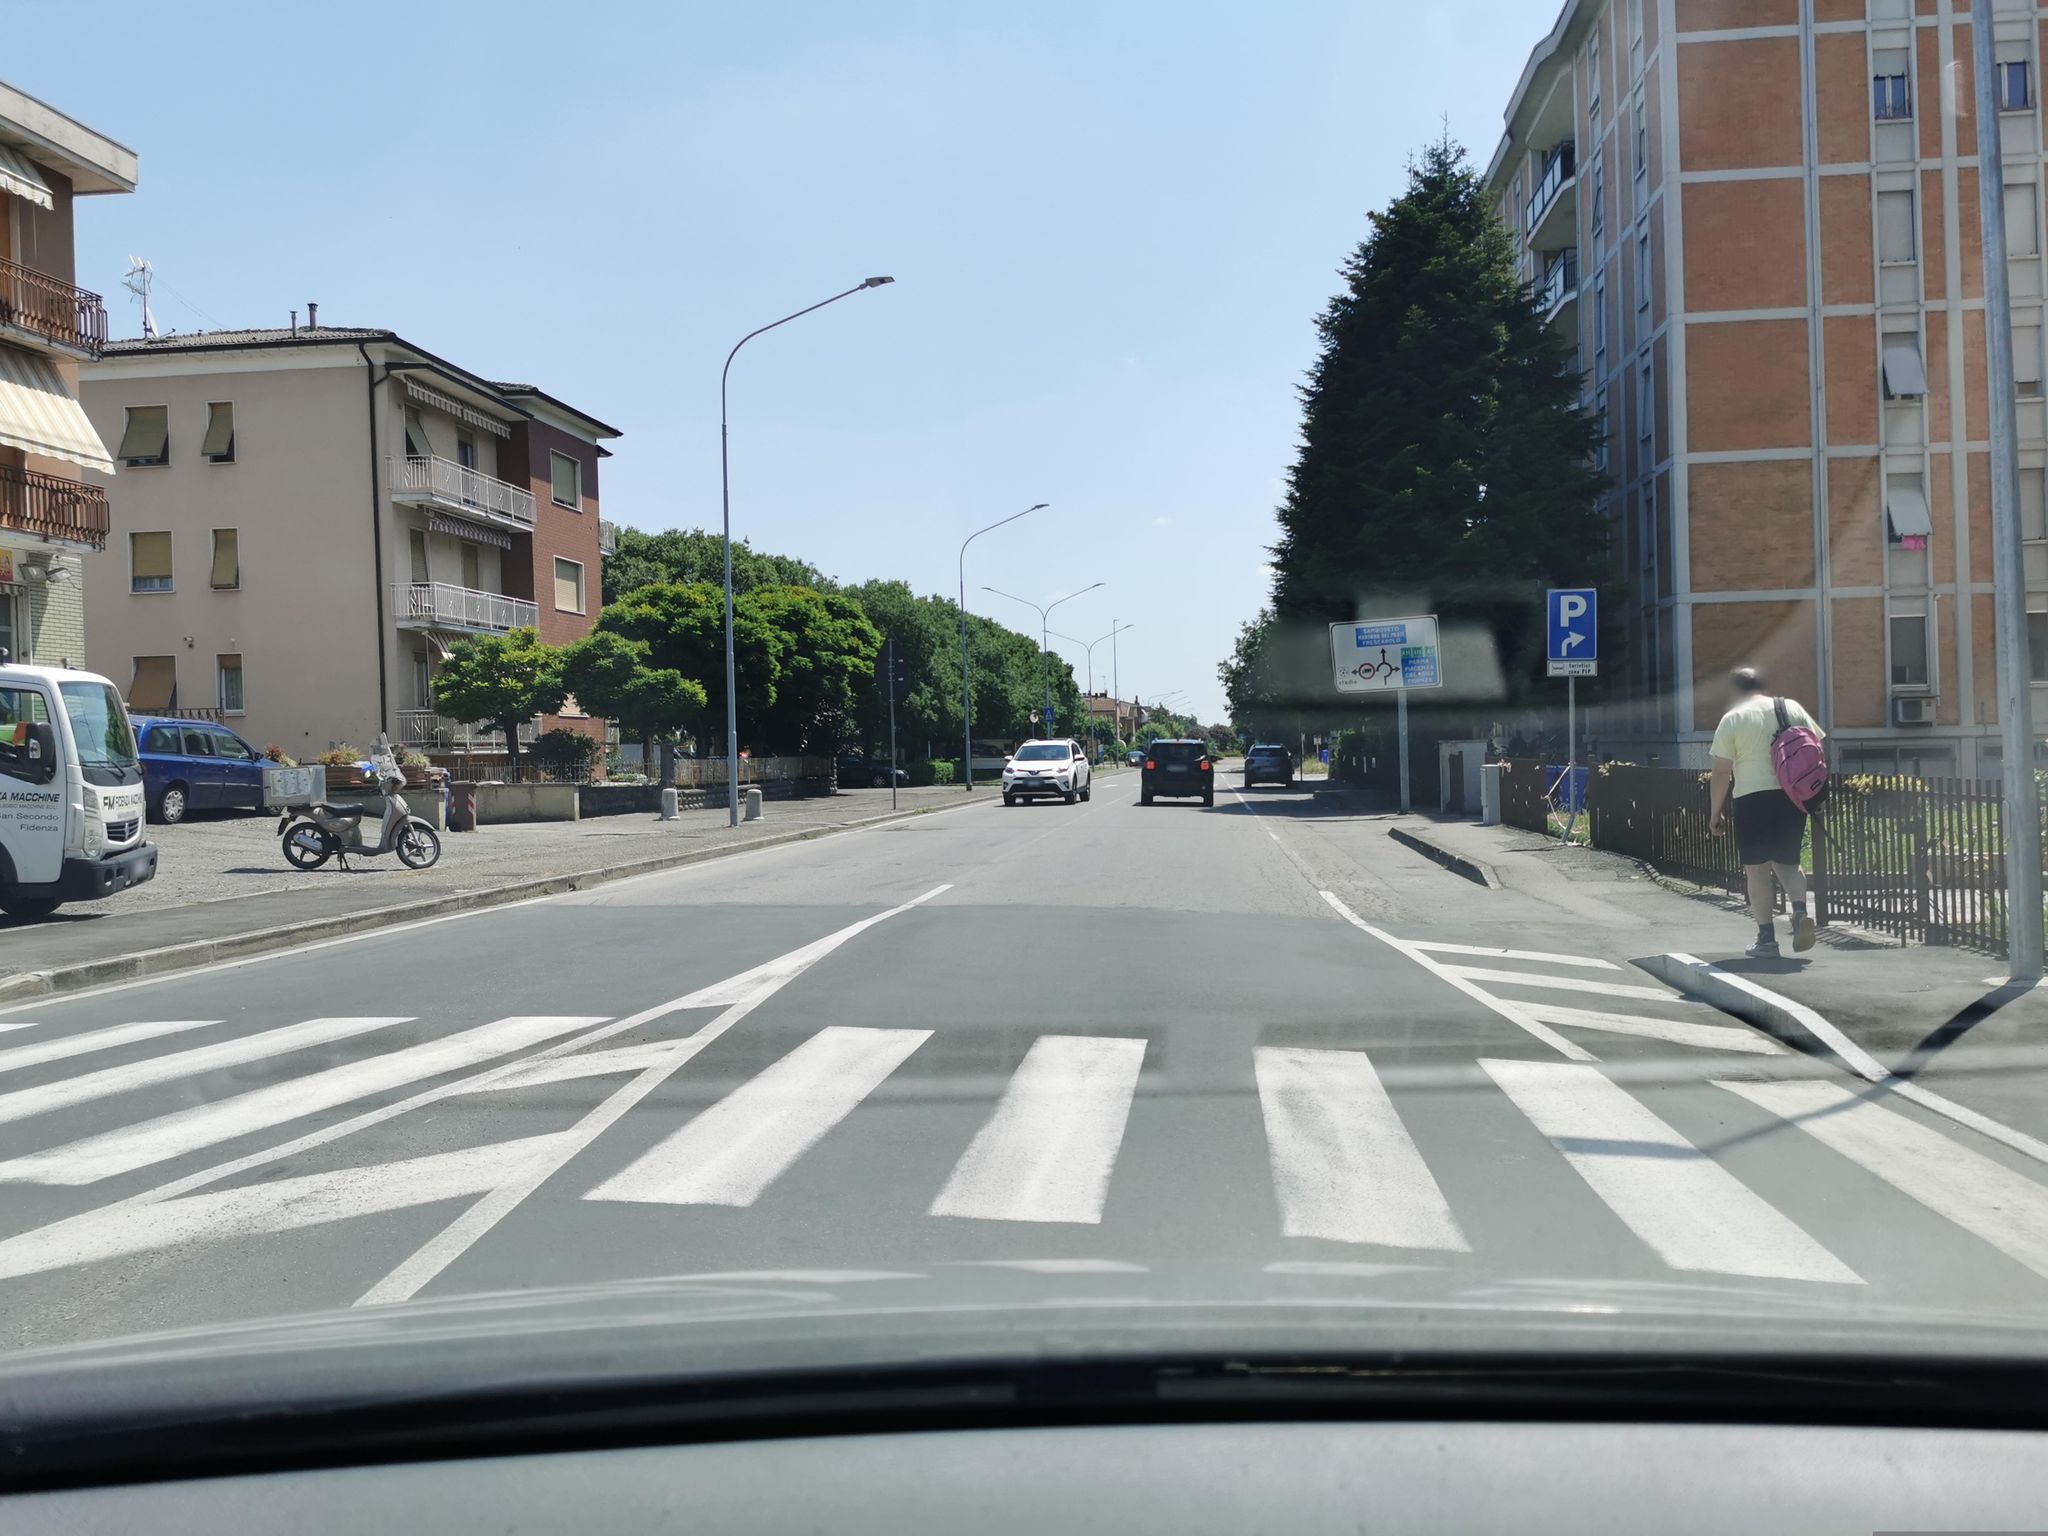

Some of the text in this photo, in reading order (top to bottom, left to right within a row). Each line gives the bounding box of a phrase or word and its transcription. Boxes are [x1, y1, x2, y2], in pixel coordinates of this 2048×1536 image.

[1560, 595, 1587, 628] P
[11, 792, 60, 802] MACCHINE
[16, 812, 59, 820] Secondo
[20, 823, 59, 831] Fidenza
